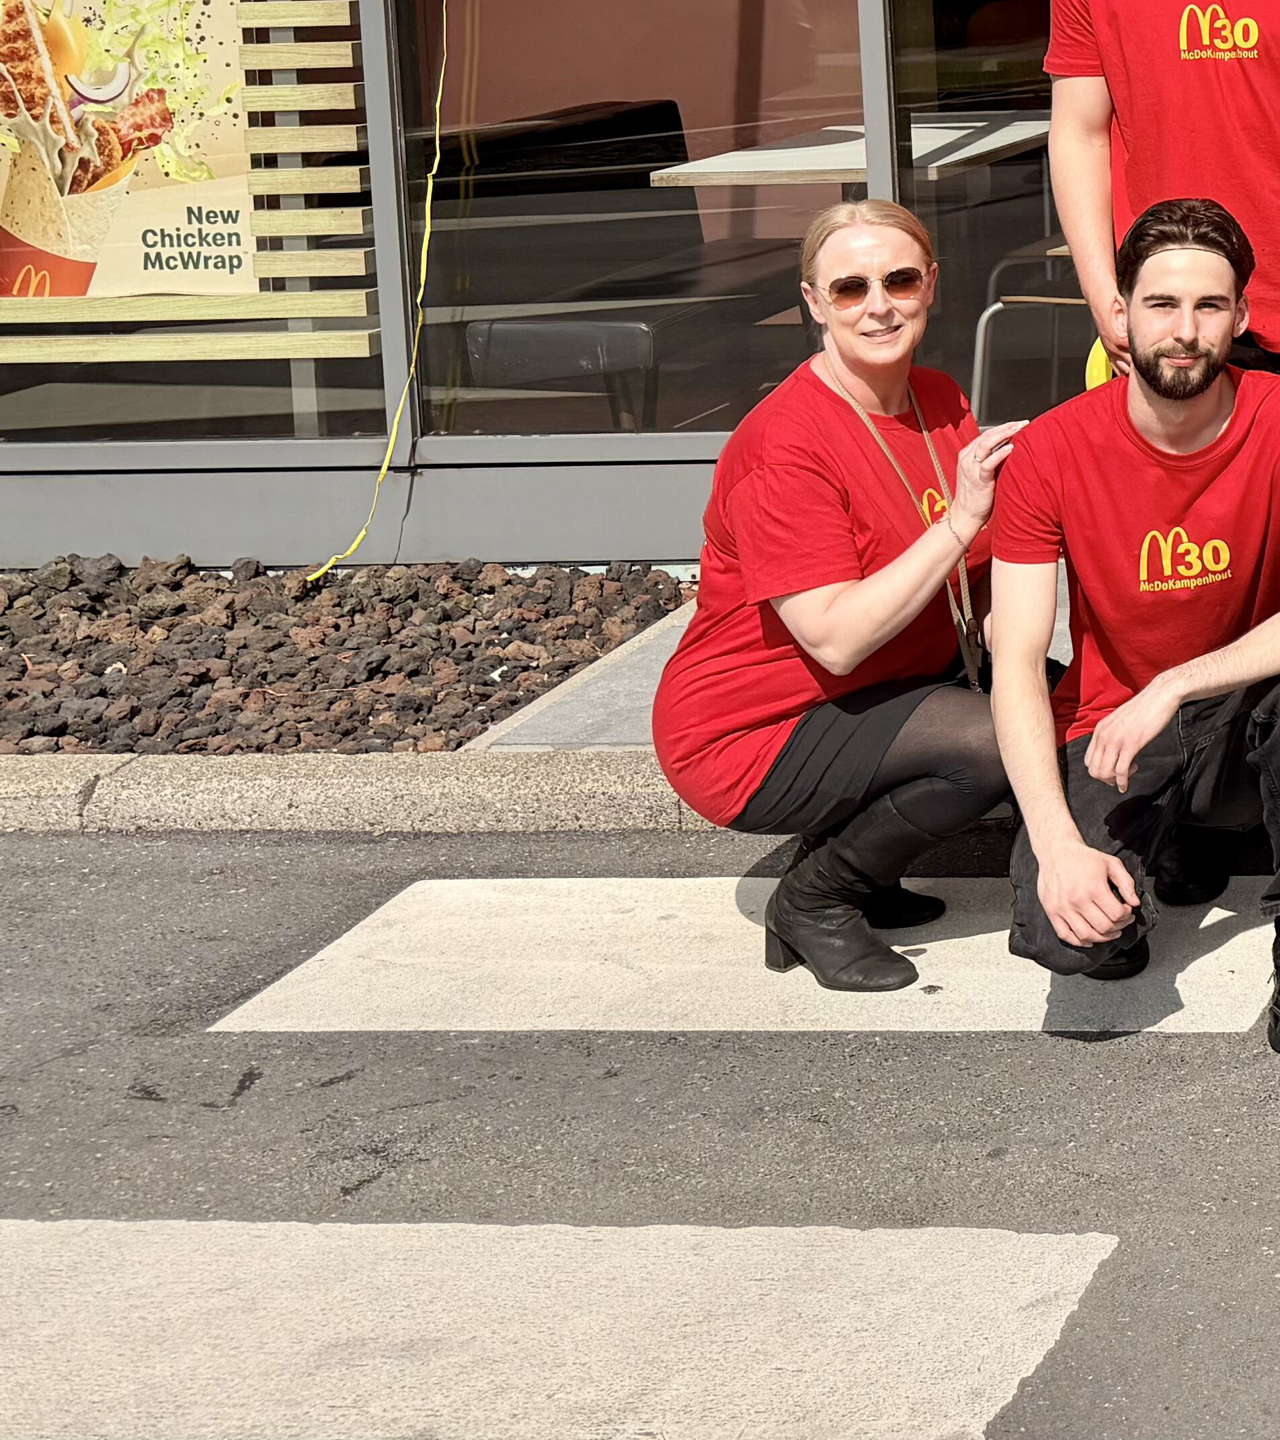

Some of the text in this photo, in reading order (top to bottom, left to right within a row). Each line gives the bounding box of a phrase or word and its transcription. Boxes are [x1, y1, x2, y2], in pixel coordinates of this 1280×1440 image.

[186, 206, 240, 225] New
[141, 227, 242, 249] Chicken
[143, 250, 243, 275] McWrap
[1139, 569, 1232, 592] McDoKampenhout
